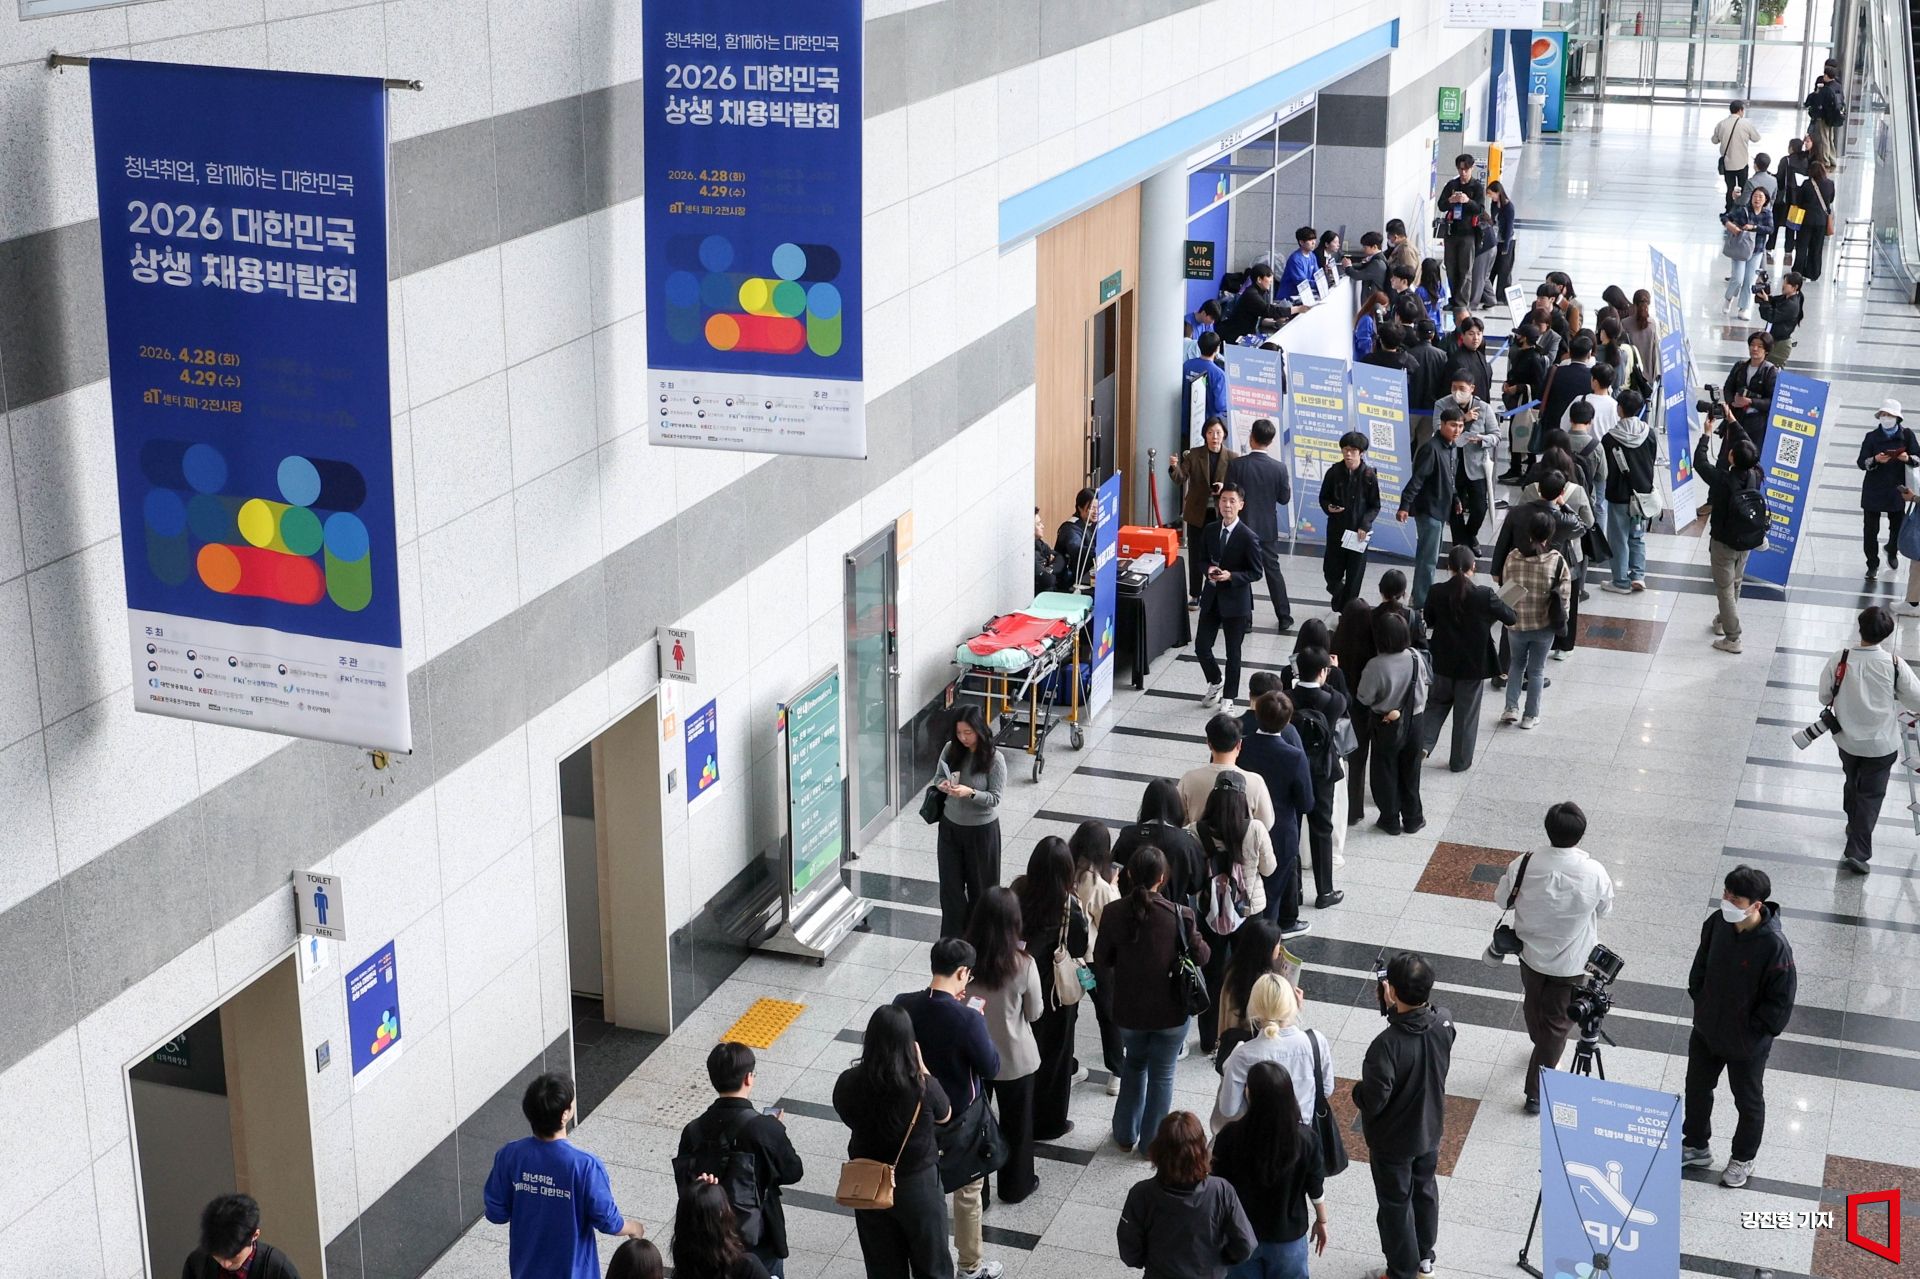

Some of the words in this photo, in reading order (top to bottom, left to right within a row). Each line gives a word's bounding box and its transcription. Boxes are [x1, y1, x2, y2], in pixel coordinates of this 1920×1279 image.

[665, 32, 720, 50] 청년취업,
[725, 33, 780, 50] 함께하는
[784, 34, 839, 52] 대한민국
[665, 64, 737, 90] 2026
[744, 64, 839, 93] 대한민국
[665, 95, 713, 125] 상생
[720, 98, 839, 129] 채용박람회
[124, 156, 200, 185] 청년취업,
[206, 162, 276, 190] 함께하는
[282, 170, 354, 196] 대한민국
[668, 170, 696, 181] 2026.
[128, 200, 223, 240] 2026
[232, 208, 356, 254] 대한민국
[1193, 246, 1208, 254] VIP
[1189, 258, 1211, 266] Suite
[130, 242, 192, 287] 상생
[202, 253, 356, 304] 채용박람회
[140, 346, 176, 362] 2026.
[1795, 422, 1808, 432] 안내
[668, 630, 687, 638] TOILET
[670, 673, 690, 681] WOMEN
[198, 687, 213, 696] KBIZ
[307, 874, 332, 885] TOILET
[316, 928, 332, 937] MEN
[512, 1182, 538, 1194] 께하는
[540, 1186, 571, 1200] 대한민국
